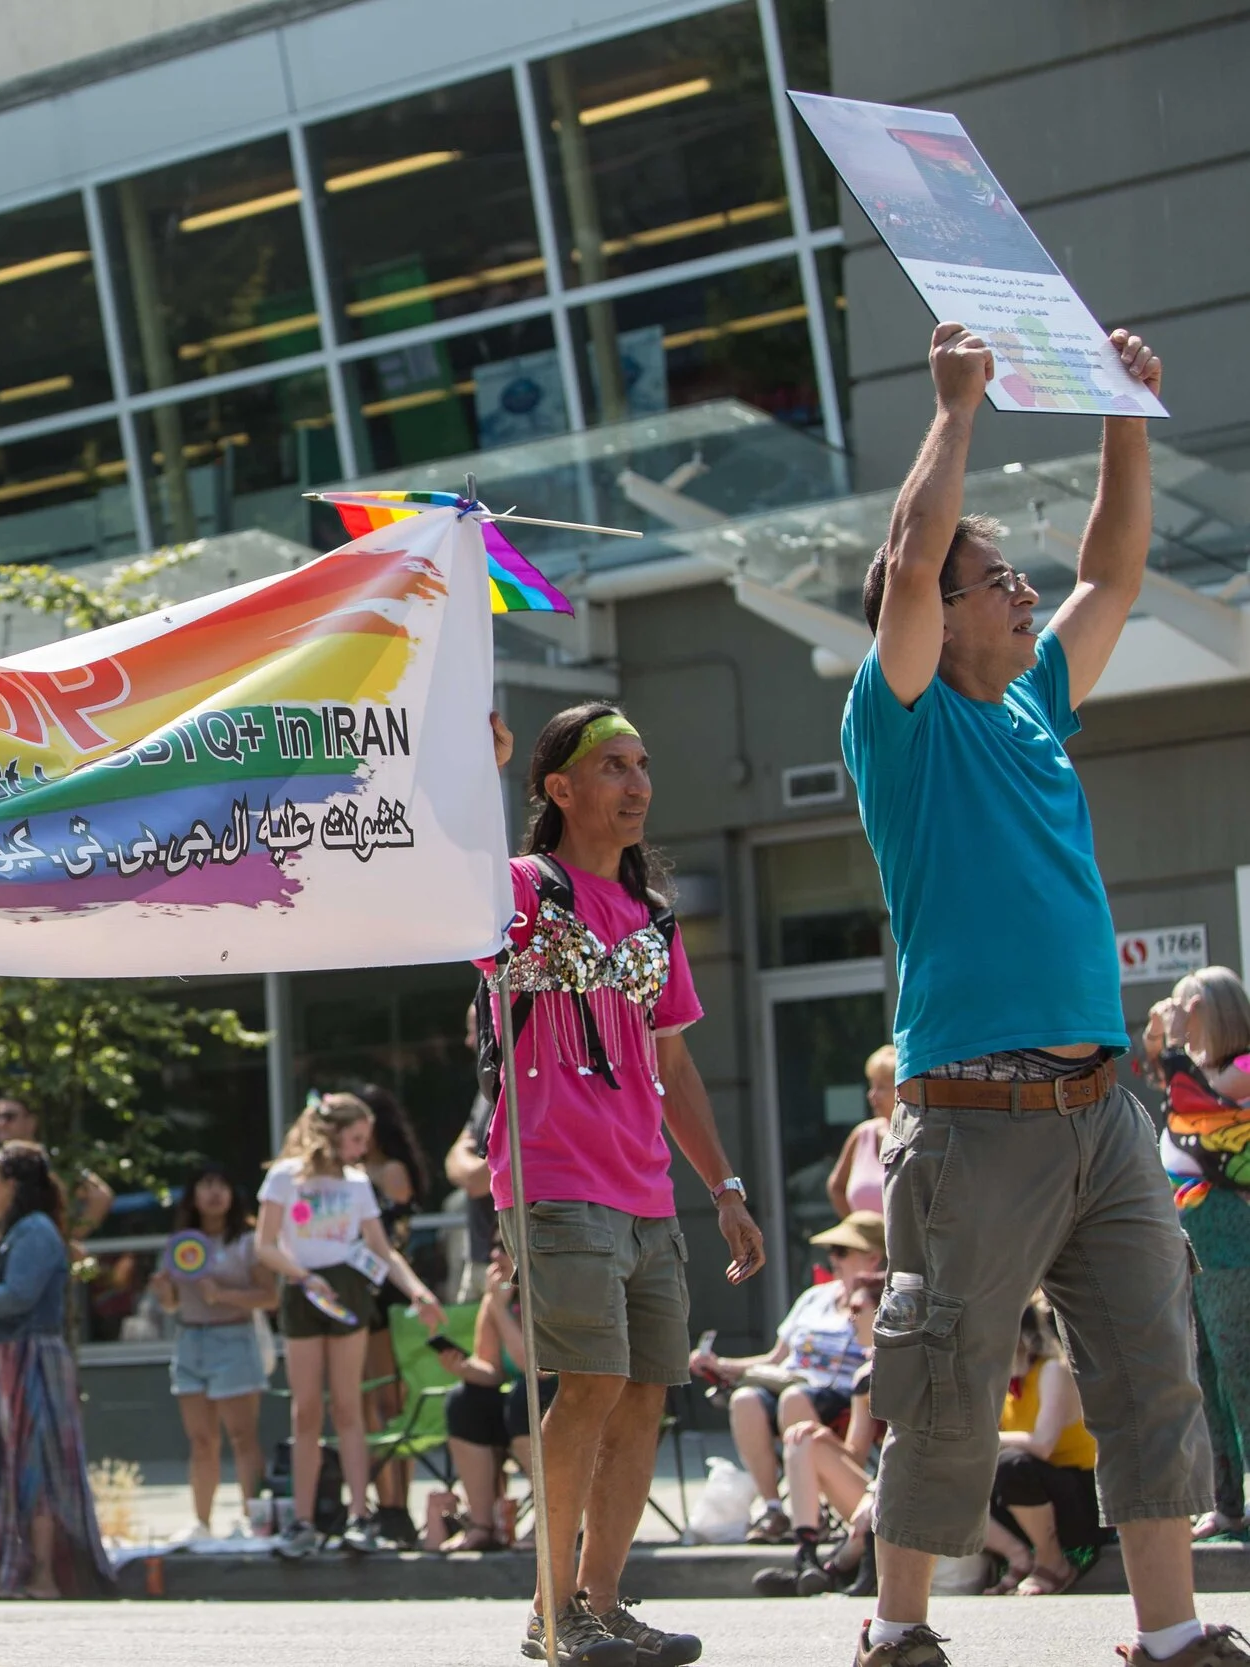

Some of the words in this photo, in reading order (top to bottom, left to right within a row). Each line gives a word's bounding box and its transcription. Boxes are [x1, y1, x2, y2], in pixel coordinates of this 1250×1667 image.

[33, 709, 263, 784] BTQ+
[275, 706, 314, 759] in
[326, 706, 410, 757] IRAN
[257, 794, 316, 866] علیه
[320, 797, 414, 861] خشونت
[1157, 932, 1201, 955] 1766
